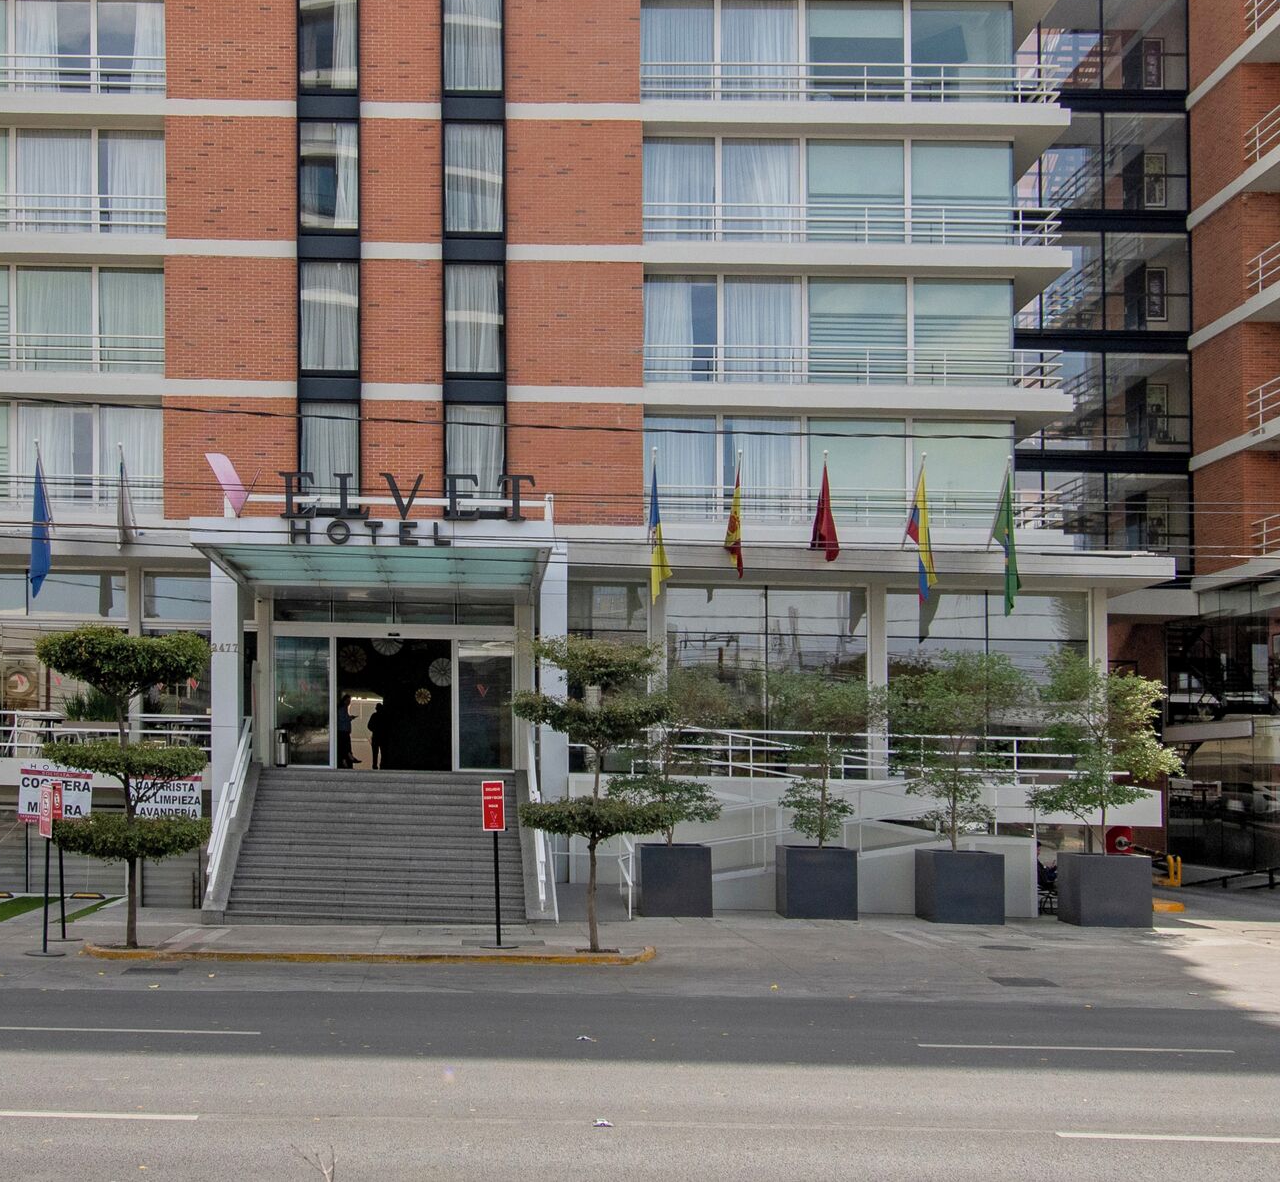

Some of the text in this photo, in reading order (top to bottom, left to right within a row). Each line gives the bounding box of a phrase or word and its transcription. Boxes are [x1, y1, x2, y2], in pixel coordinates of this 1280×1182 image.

[204, 452, 536, 522] VELVET
[290, 520, 452, 546] HOTEL
[154, 794, 201, 805] LIMPIEZA
